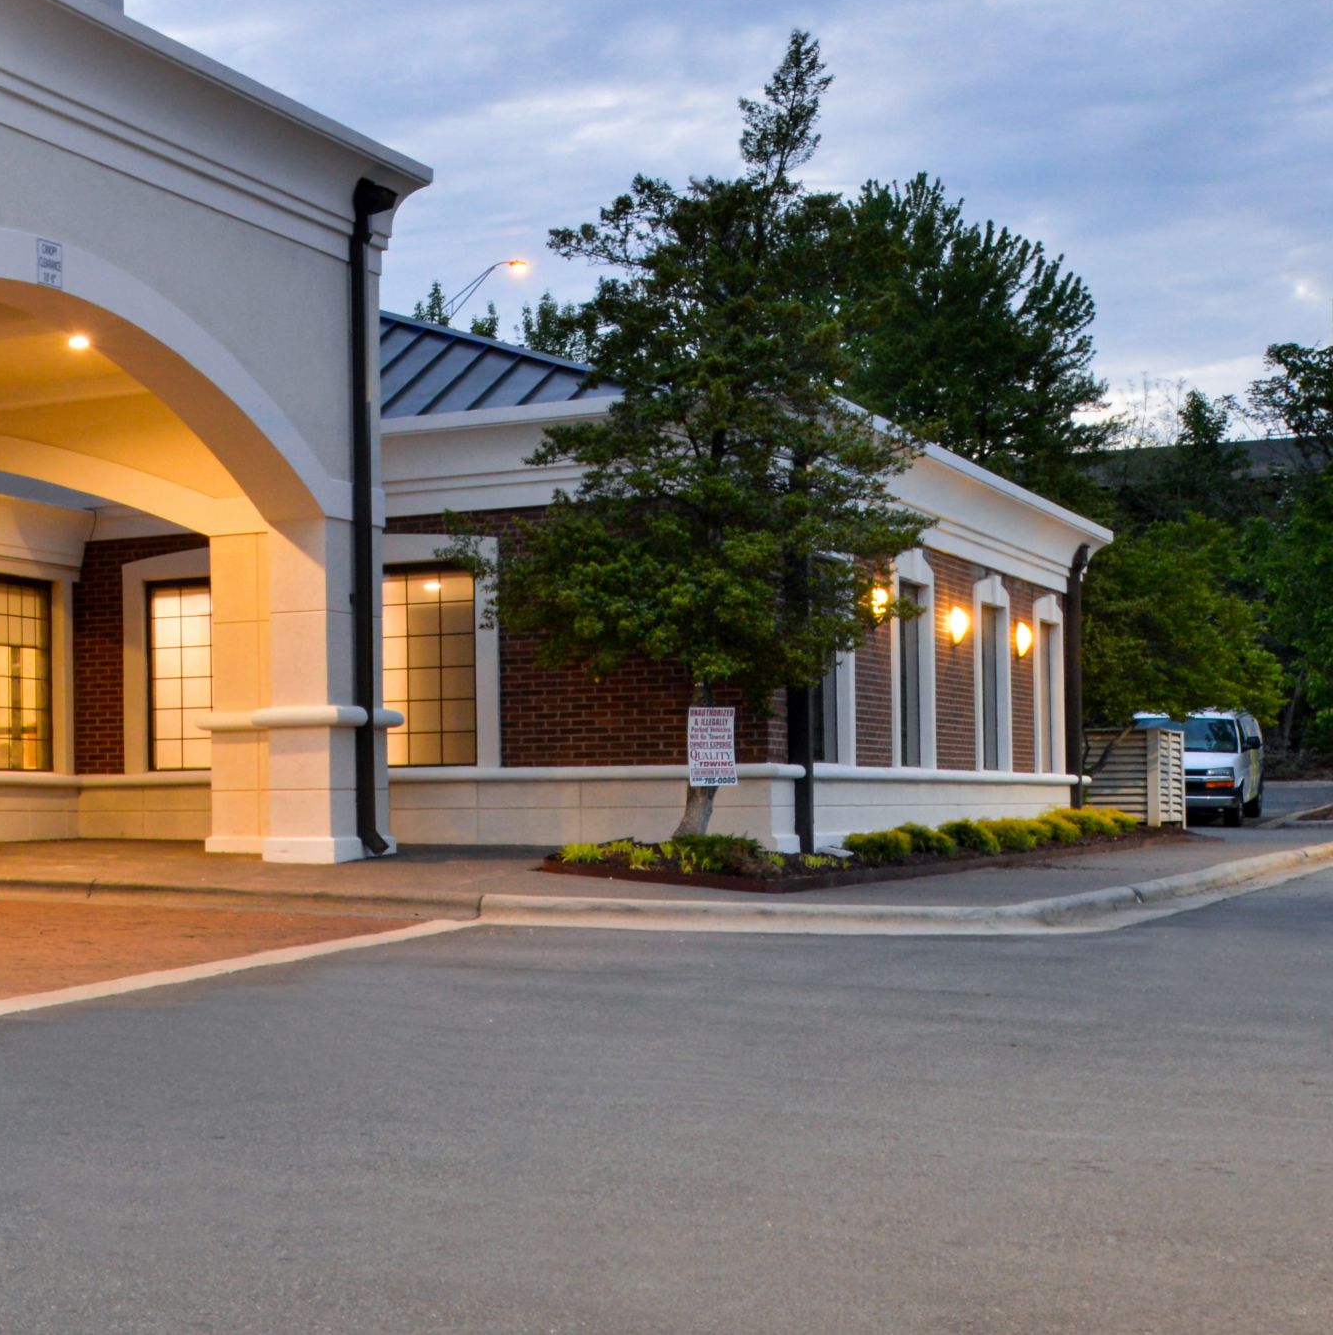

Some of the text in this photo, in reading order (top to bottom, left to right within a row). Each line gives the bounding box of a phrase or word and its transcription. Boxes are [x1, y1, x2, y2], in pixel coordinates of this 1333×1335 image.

[689, 709, 734, 717] UNAUTHORIZED
[700, 718, 729, 726] ILLEGALLY
[690, 749, 733, 762] QUALITY
